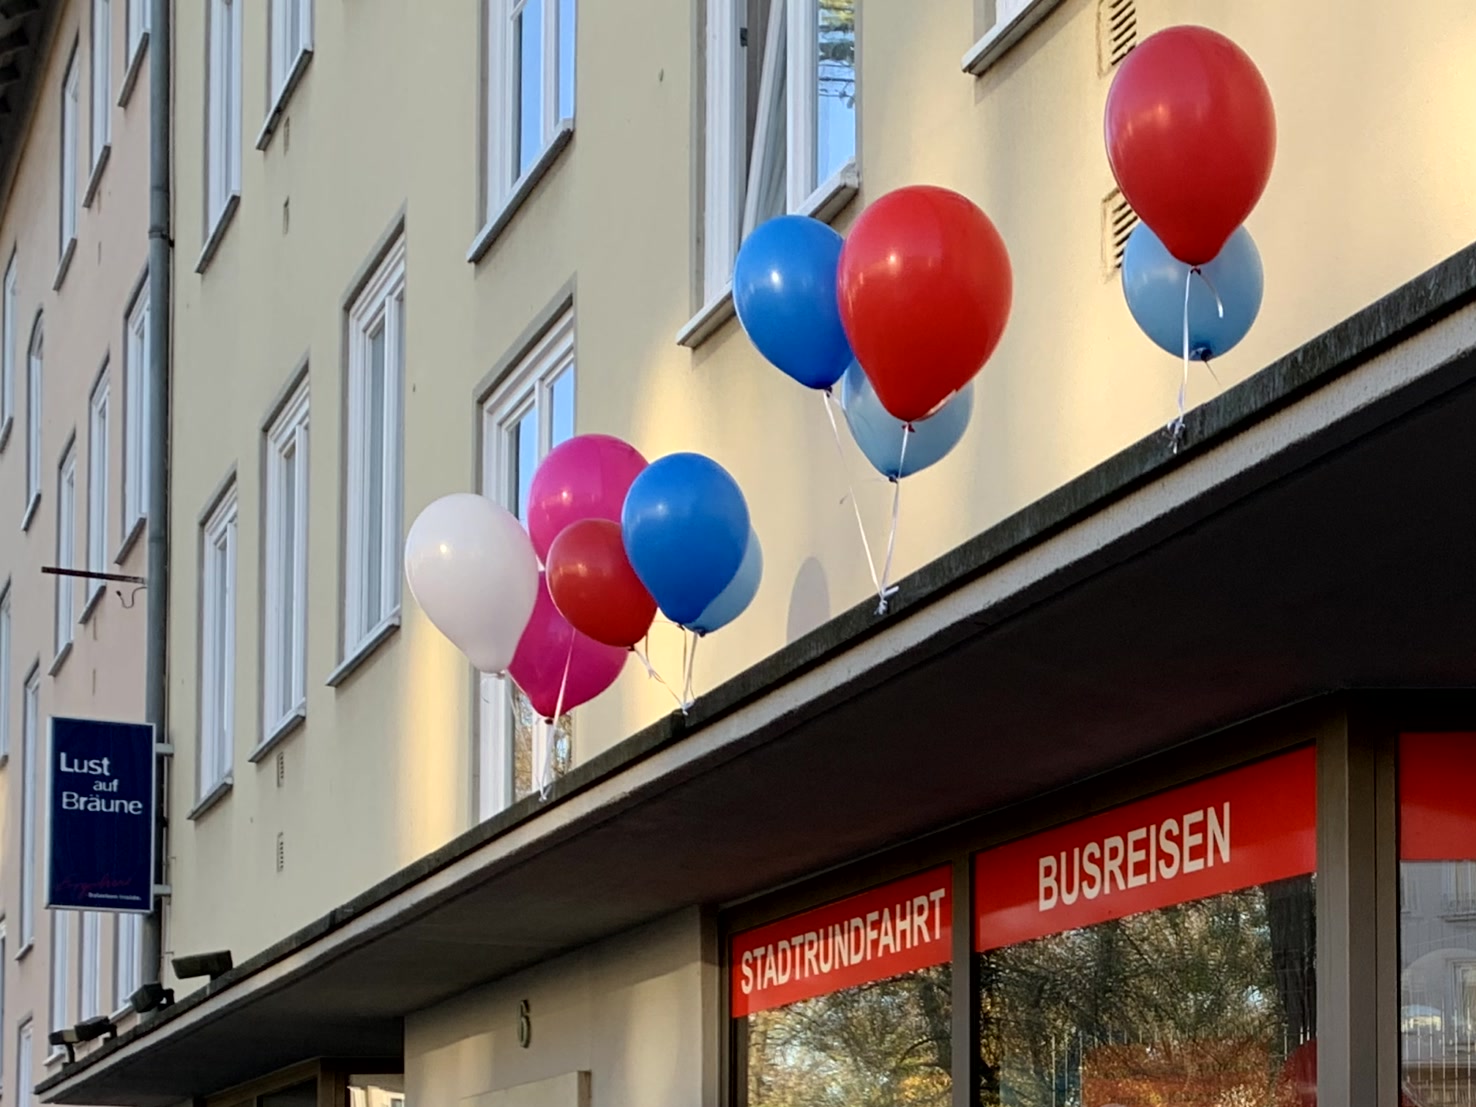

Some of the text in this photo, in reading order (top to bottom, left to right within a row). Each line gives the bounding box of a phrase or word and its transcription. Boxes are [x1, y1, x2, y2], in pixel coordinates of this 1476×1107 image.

[60, 752, 110, 776] Lust
[62, 791, 143, 815] Bräune
[92, 779, 119, 792] auf
[1038, 801, 1231, 912] BUSREISEN
[740, 888, 945, 995] STADTRUNDFAHRT
[517, 999, 532, 1049] 6
